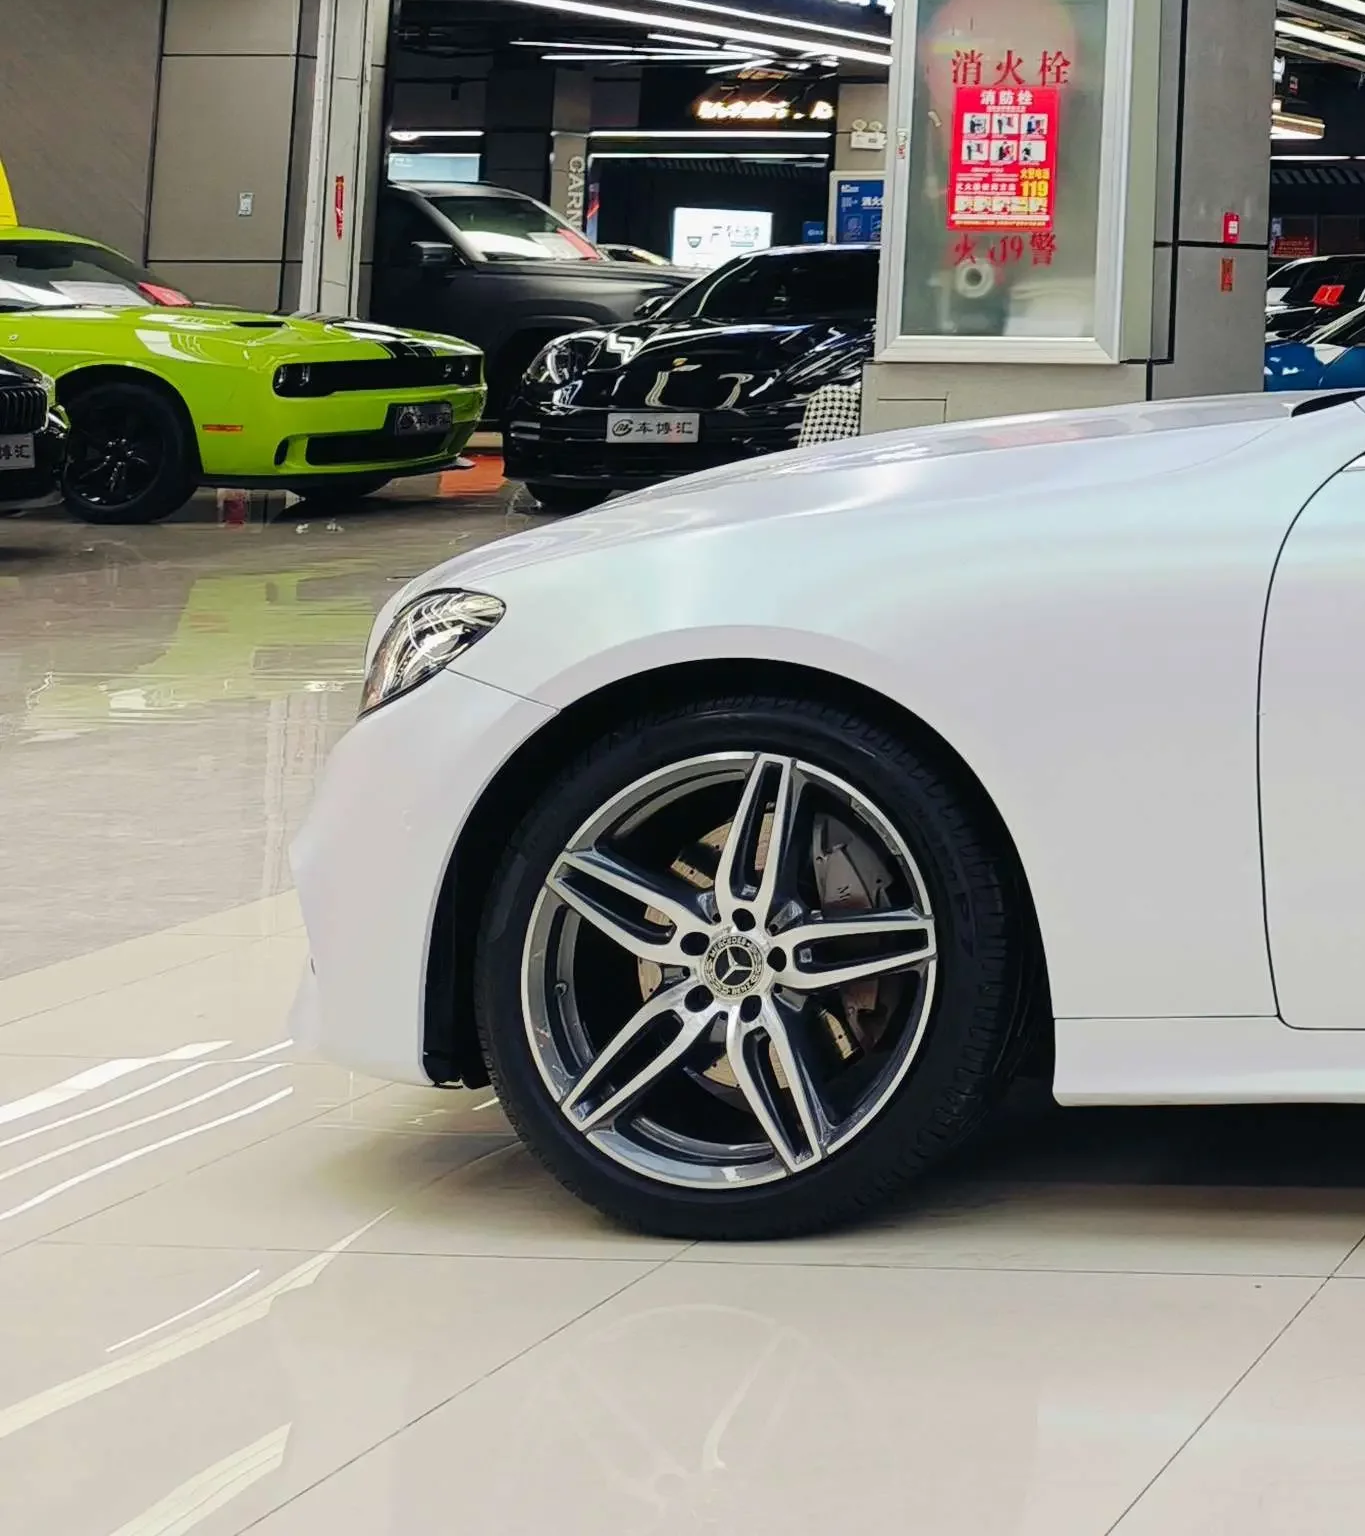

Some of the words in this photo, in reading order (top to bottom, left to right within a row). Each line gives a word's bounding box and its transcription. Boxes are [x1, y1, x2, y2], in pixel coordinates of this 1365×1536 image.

[952, 50, 1071, 85] 消火栓
[566, 156, 585, 232] CARN
[1020, 180, 1049, 196] 119
